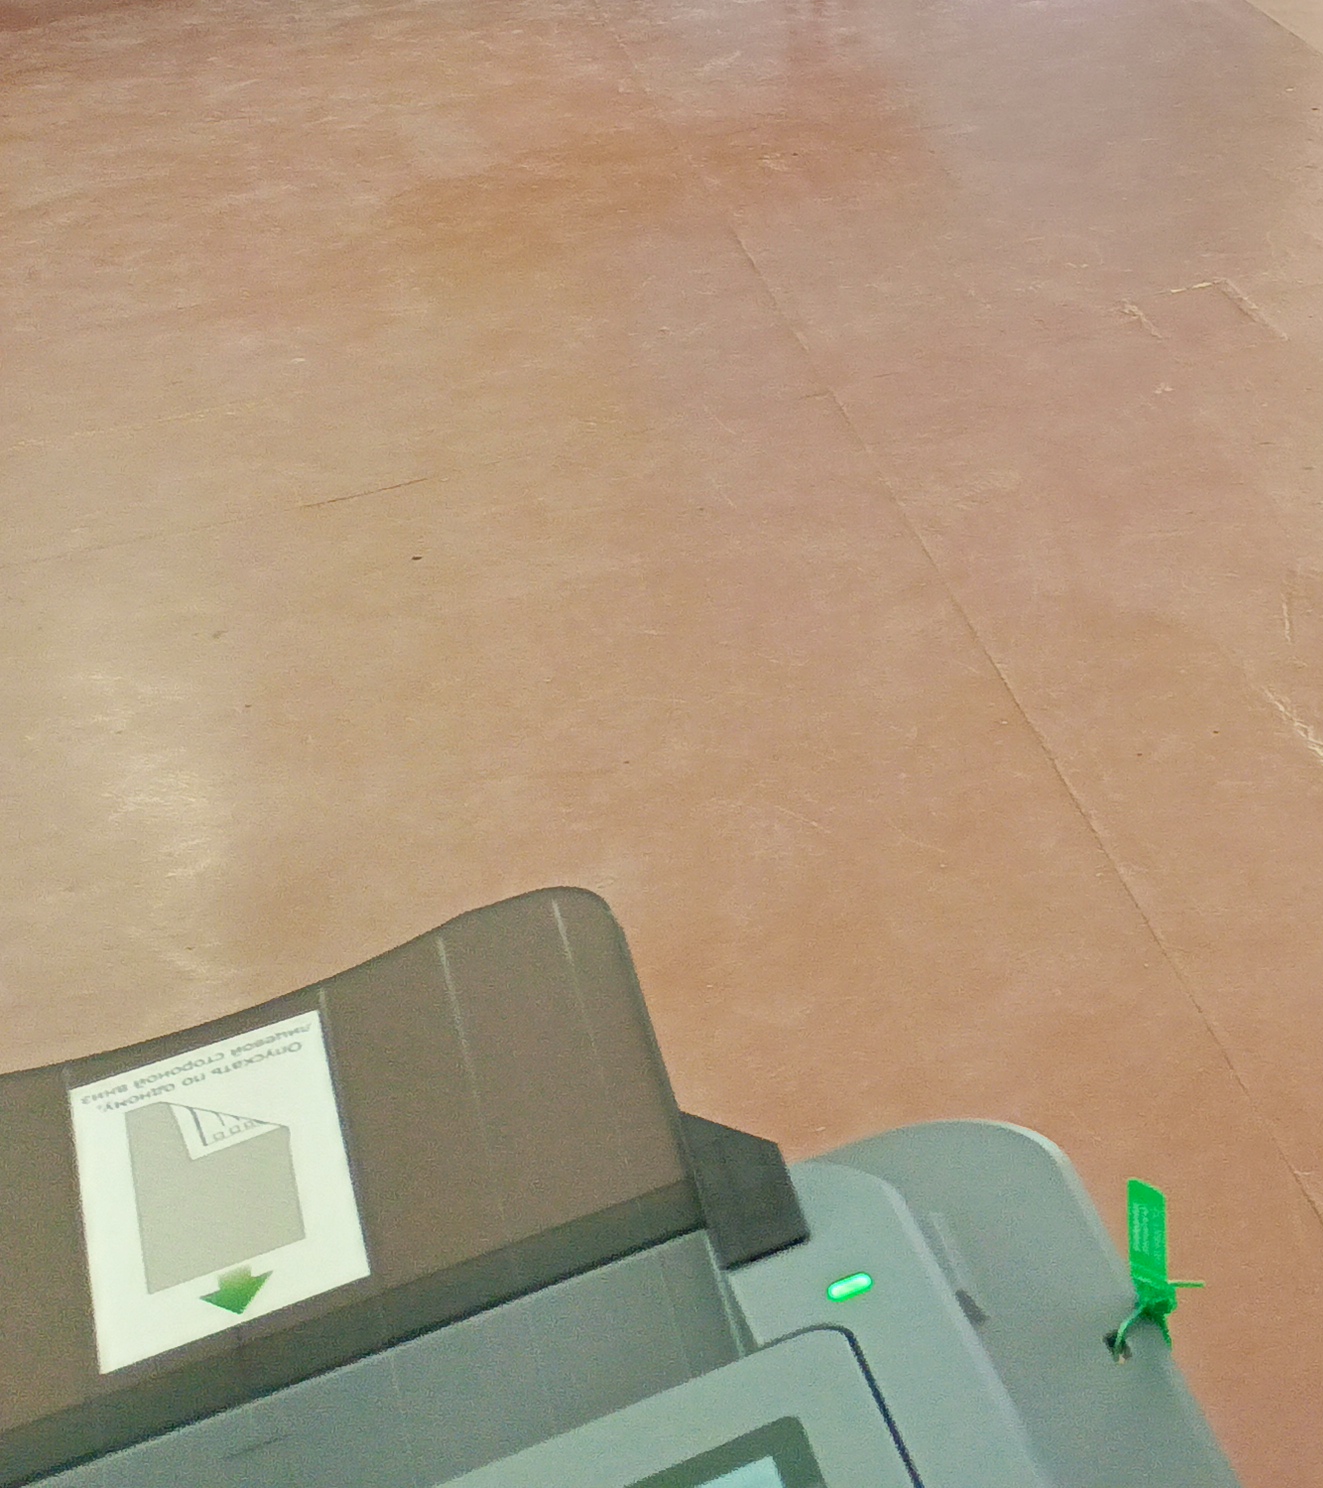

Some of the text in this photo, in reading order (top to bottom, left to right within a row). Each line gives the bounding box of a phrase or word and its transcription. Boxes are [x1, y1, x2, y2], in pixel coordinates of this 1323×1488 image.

[80, 1022, 312, 1105] лицевой стороной вниз
[211, 1041, 303, 1075] Опускать
[181, 1072, 206, 1087] по
